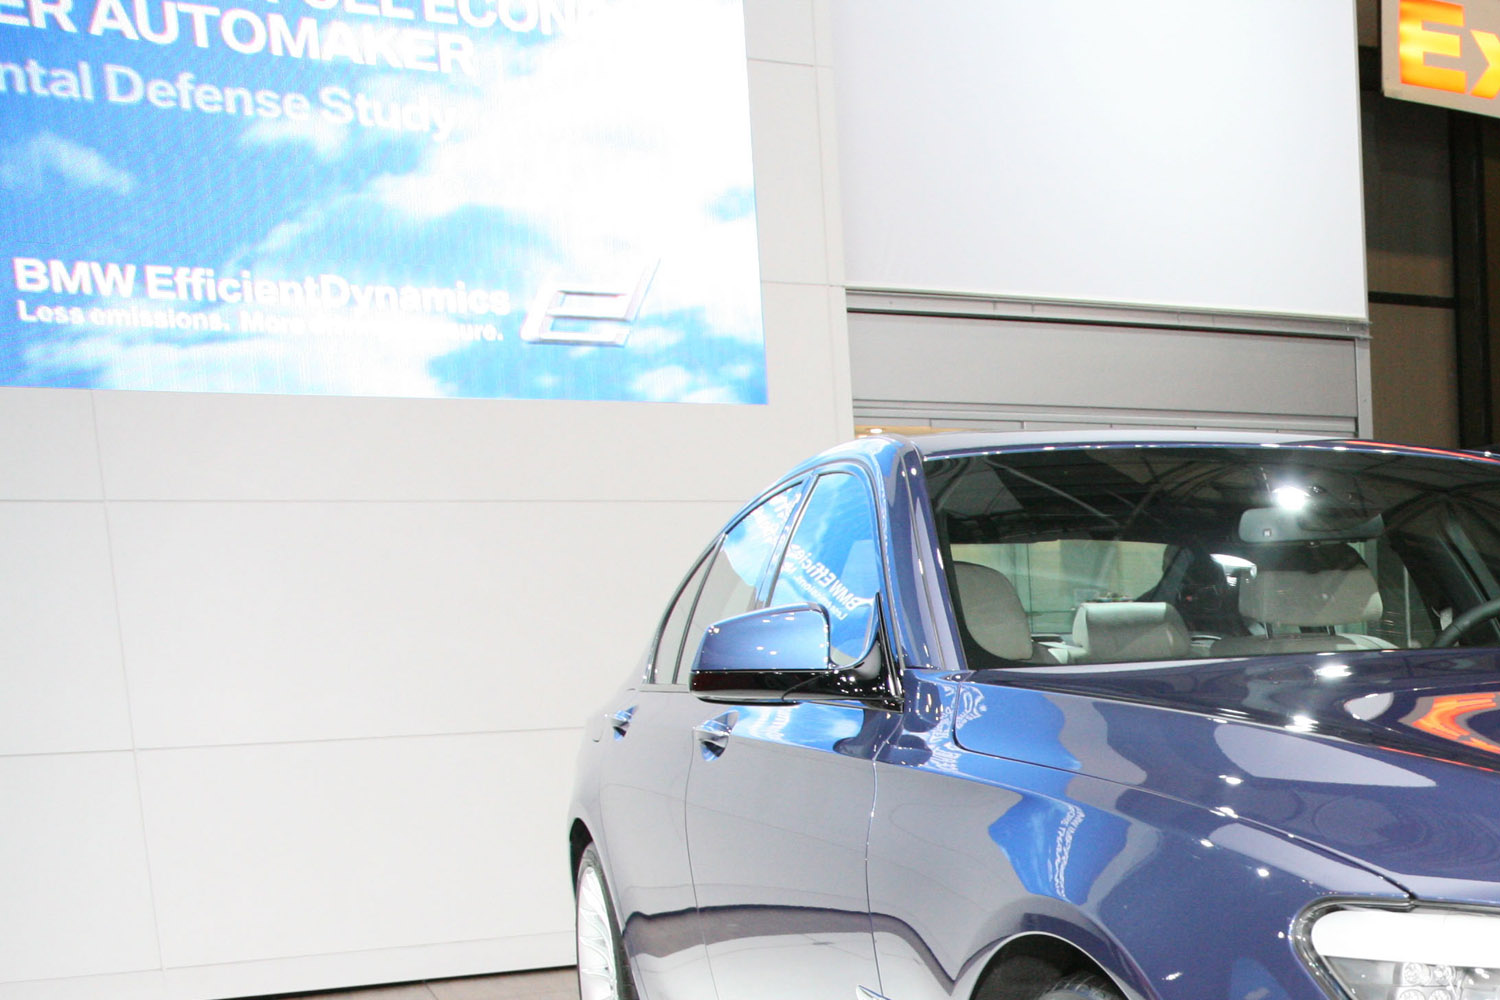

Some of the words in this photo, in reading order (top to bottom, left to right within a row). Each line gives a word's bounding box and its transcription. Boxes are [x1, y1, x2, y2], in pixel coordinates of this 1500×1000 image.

[88, 0, 479, 76] AUTOMAKER
[103, 62, 311, 121] Defense
[319, 84, 458, 142] Study
[13, 257, 136, 298] BMW
[145, 263, 512, 316] EfficientDynamics
[18, 300, 84, 325] Less
